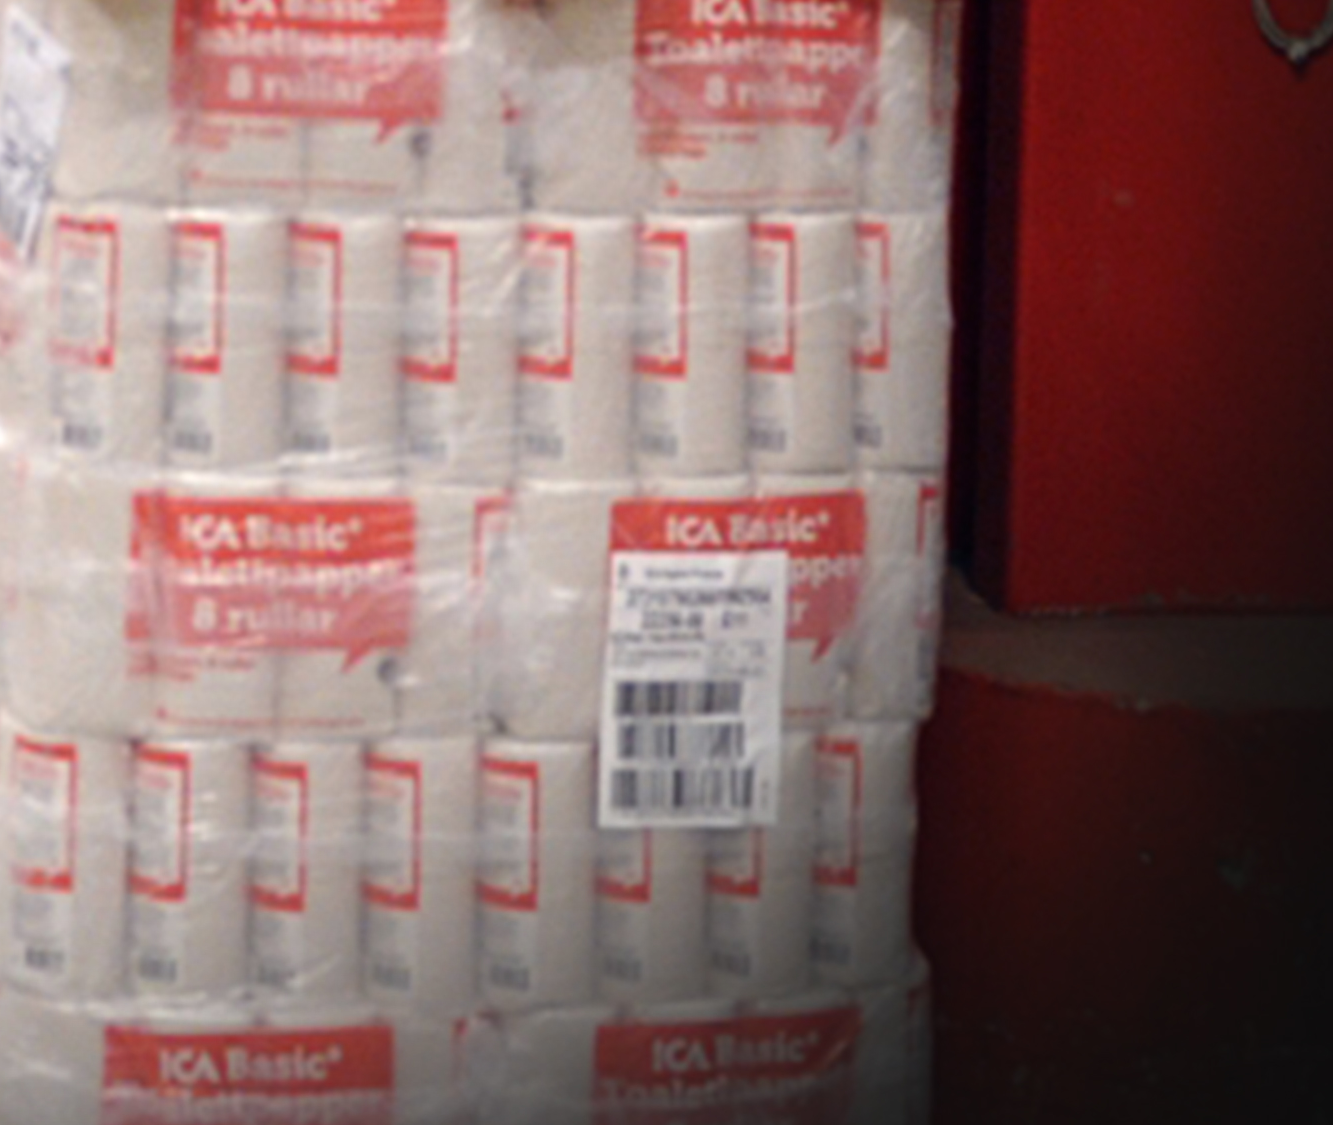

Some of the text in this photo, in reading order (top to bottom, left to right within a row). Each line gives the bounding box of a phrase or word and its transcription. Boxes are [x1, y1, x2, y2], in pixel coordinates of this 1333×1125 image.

[180, 512, 242, 551] ICA
[666, 512, 723, 547] ICA
[158, 1048, 221, 1084] ICA
[650, 1034, 712, 1074] ICA
